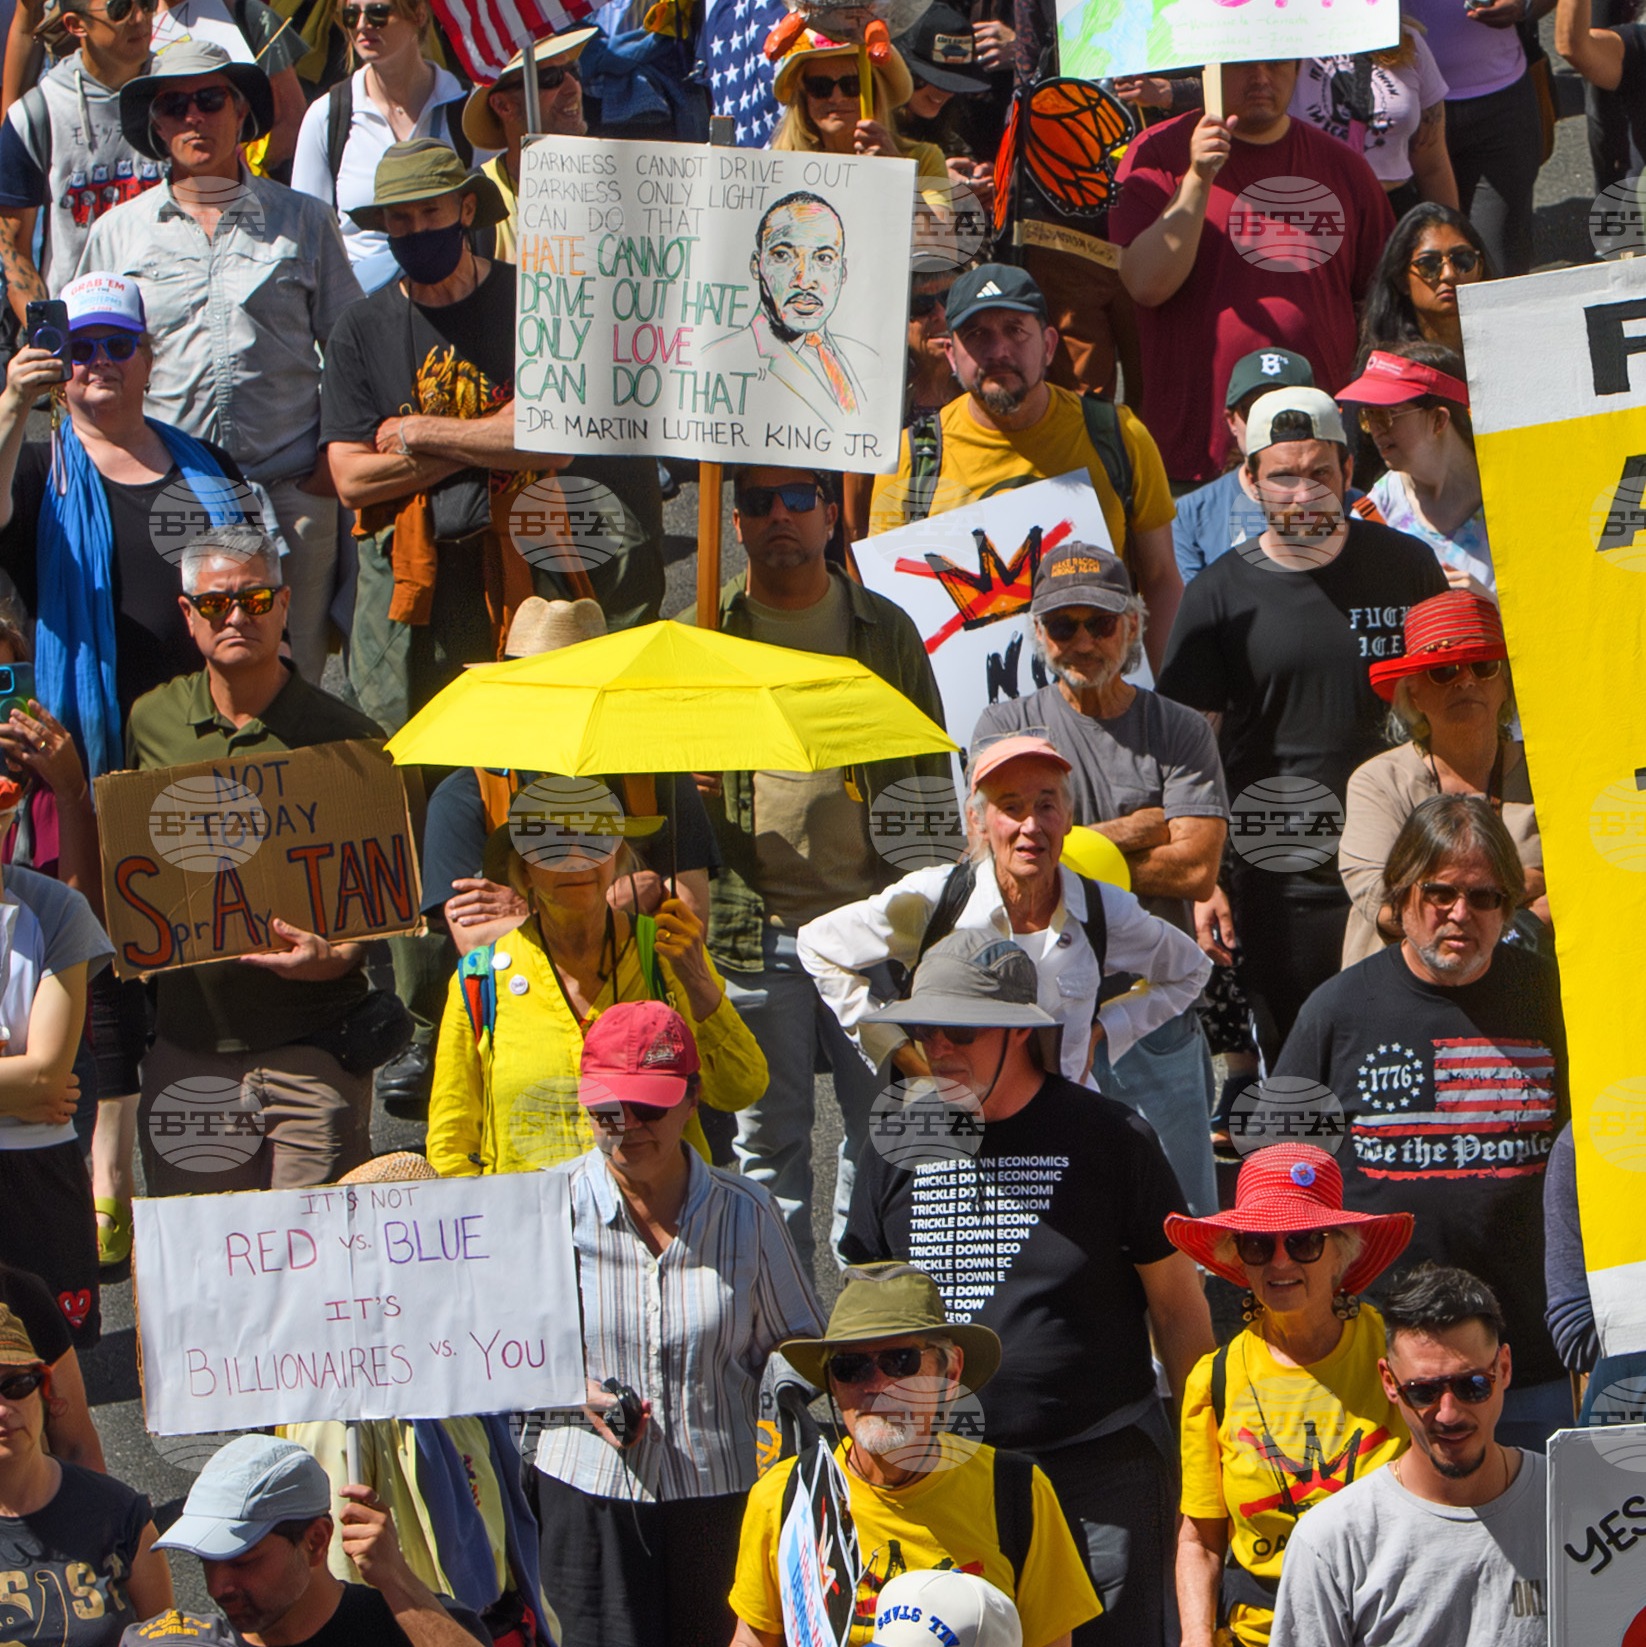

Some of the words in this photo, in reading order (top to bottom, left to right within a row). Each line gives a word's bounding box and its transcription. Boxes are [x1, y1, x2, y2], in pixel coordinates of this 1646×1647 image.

[526, 151, 617, 175] DARKNESS
[636, 155, 708, 178] CANNOT
[719, 156, 784, 183] DRIVE
[803, 161, 858, 187] OUT
[525, 179, 622, 203] DARKNESS
[637, 180, 693, 206] ONLY
[709, 185, 770, 210] LIGHT
[524, 207, 567, 231] CAN
[589, 206, 625, 233] DO
[645, 208, 704, 234] THAT
[521, 234, 586, 276] HATE
[599, 234, 700, 280] CANNOT
[520, 272, 596, 319] DRIVE
[612, 278, 677, 322] OUT
[682, 281, 749, 328] HATE
[519, 316, 591, 361] ONLY
[613, 323, 694, 366] LOVE
[516, 358, 586, 405] CAN
[613, 365, 662, 407] DO
[565, 415, 648, 441] MARTIN
[663, 417, 750, 448] LUTHER
[765, 423, 832, 453] KING
[844, 433, 882, 458] JR
[212, 762, 289, 802] NOT
[199, 801, 319, 852] TODAY
[1369, 1065, 1412, 1092] 1776
[998, 1156, 1069, 1168] ECONOMICS
[1353, 1135, 1397, 1163] We
[1401, 1136, 1448, 1169] the
[1452, 1133, 1552, 1170] People
[370, 1185, 421, 1210] NOT
[225, 1227, 319, 1277] RED
[385, 1215, 490, 1267] BLUE
[909, 1231, 954, 1244] TRICKLE
[956, 1229, 995, 1241] DOWN
[997, 1228, 1030, 1240] ECON
[909, 1245, 953, 1257] TRICKLE
[955, 1243, 995, 1255] DOWN
[997, 1243, 1021, 1254] ECO
[186, 1343, 414, 1399] BILLIONAIRES
[471, 1329, 547, 1381] YOU
